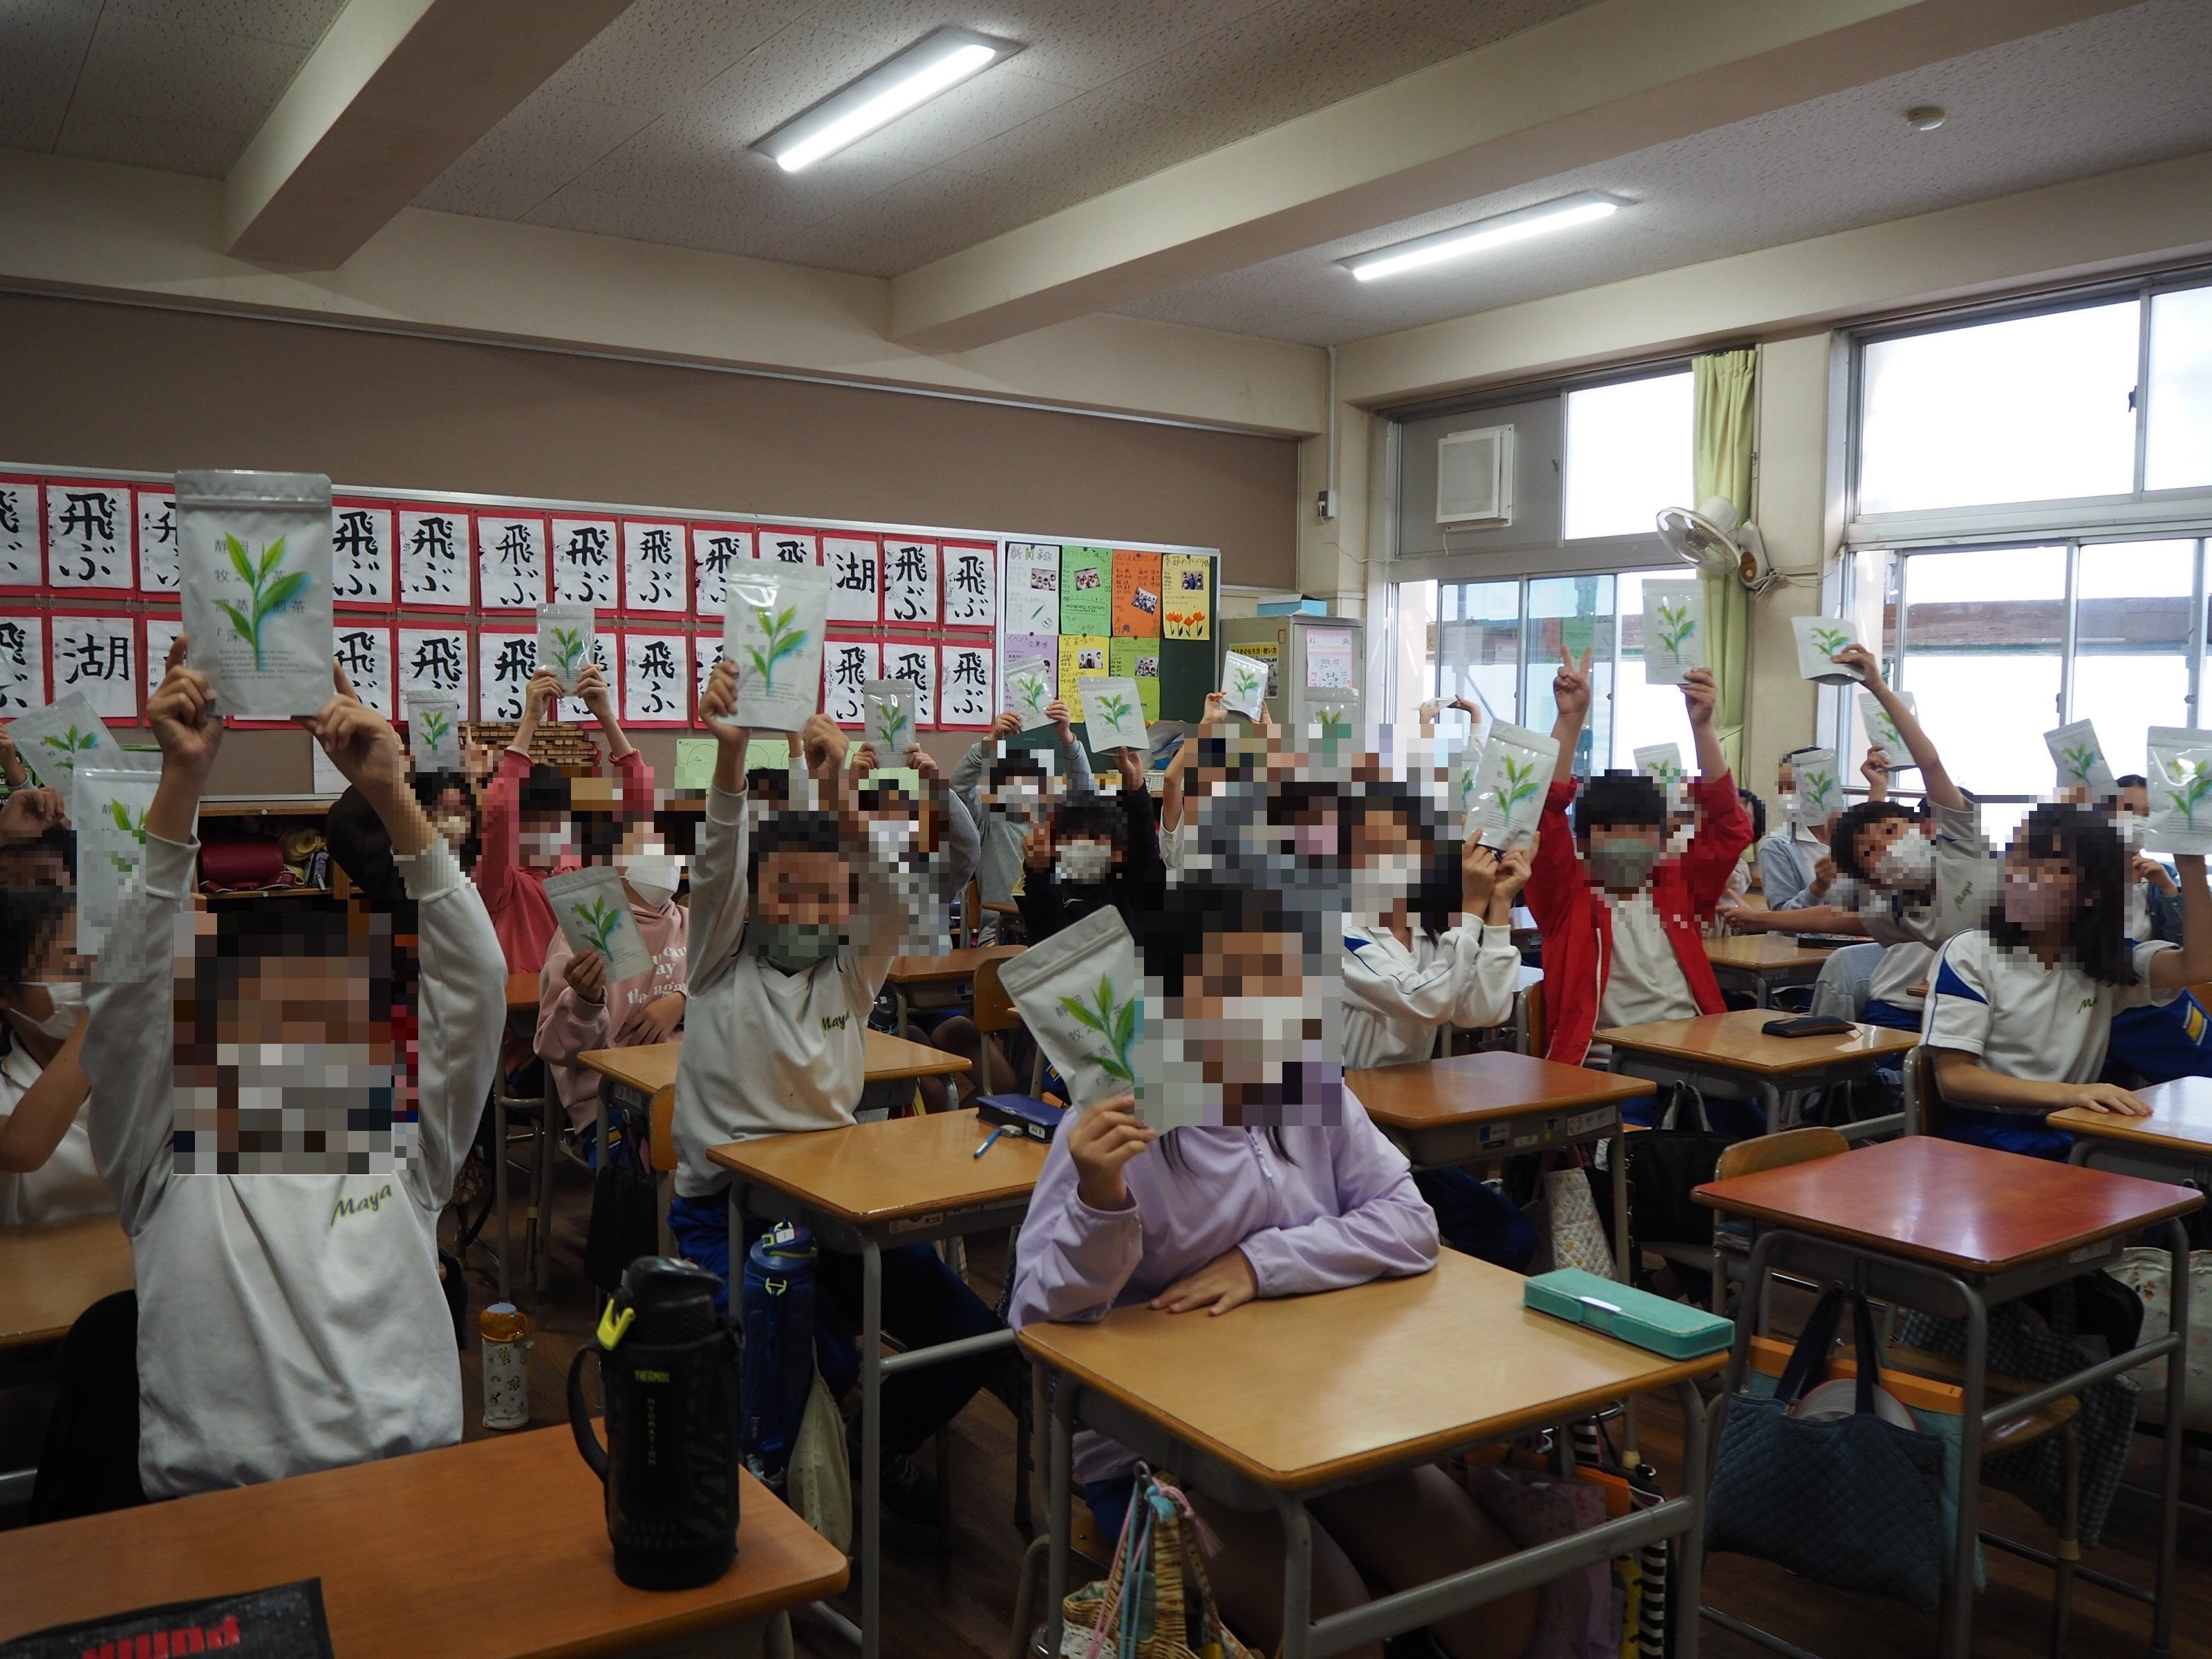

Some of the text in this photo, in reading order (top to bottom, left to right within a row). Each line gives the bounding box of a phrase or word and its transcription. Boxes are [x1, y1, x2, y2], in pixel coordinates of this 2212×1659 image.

[59, 493, 116, 581] 飛ぶ
[333, 512, 379, 596] 飛ぶ
[410, 517, 455, 592] 飛ぶ
[496, 524, 538, 605] 飛ぶ
[565, 527, 609, 602] 飛ぶ
[639, 529, 672, 603] 飛ぶ
[836, 552, 875, 593] 湖
[894, 546, 928, 620] 飛ぶ
[954, 556, 988, 617] 飛ぶ
[63, 633, 130, 684] 湖
[953, 652, 986, 713] 飛ぶ
[822, 1011, 850, 1038] Maya
[330, 1185, 392, 1226] Maya
[635, 1370, 670, 1382] THERMOS
